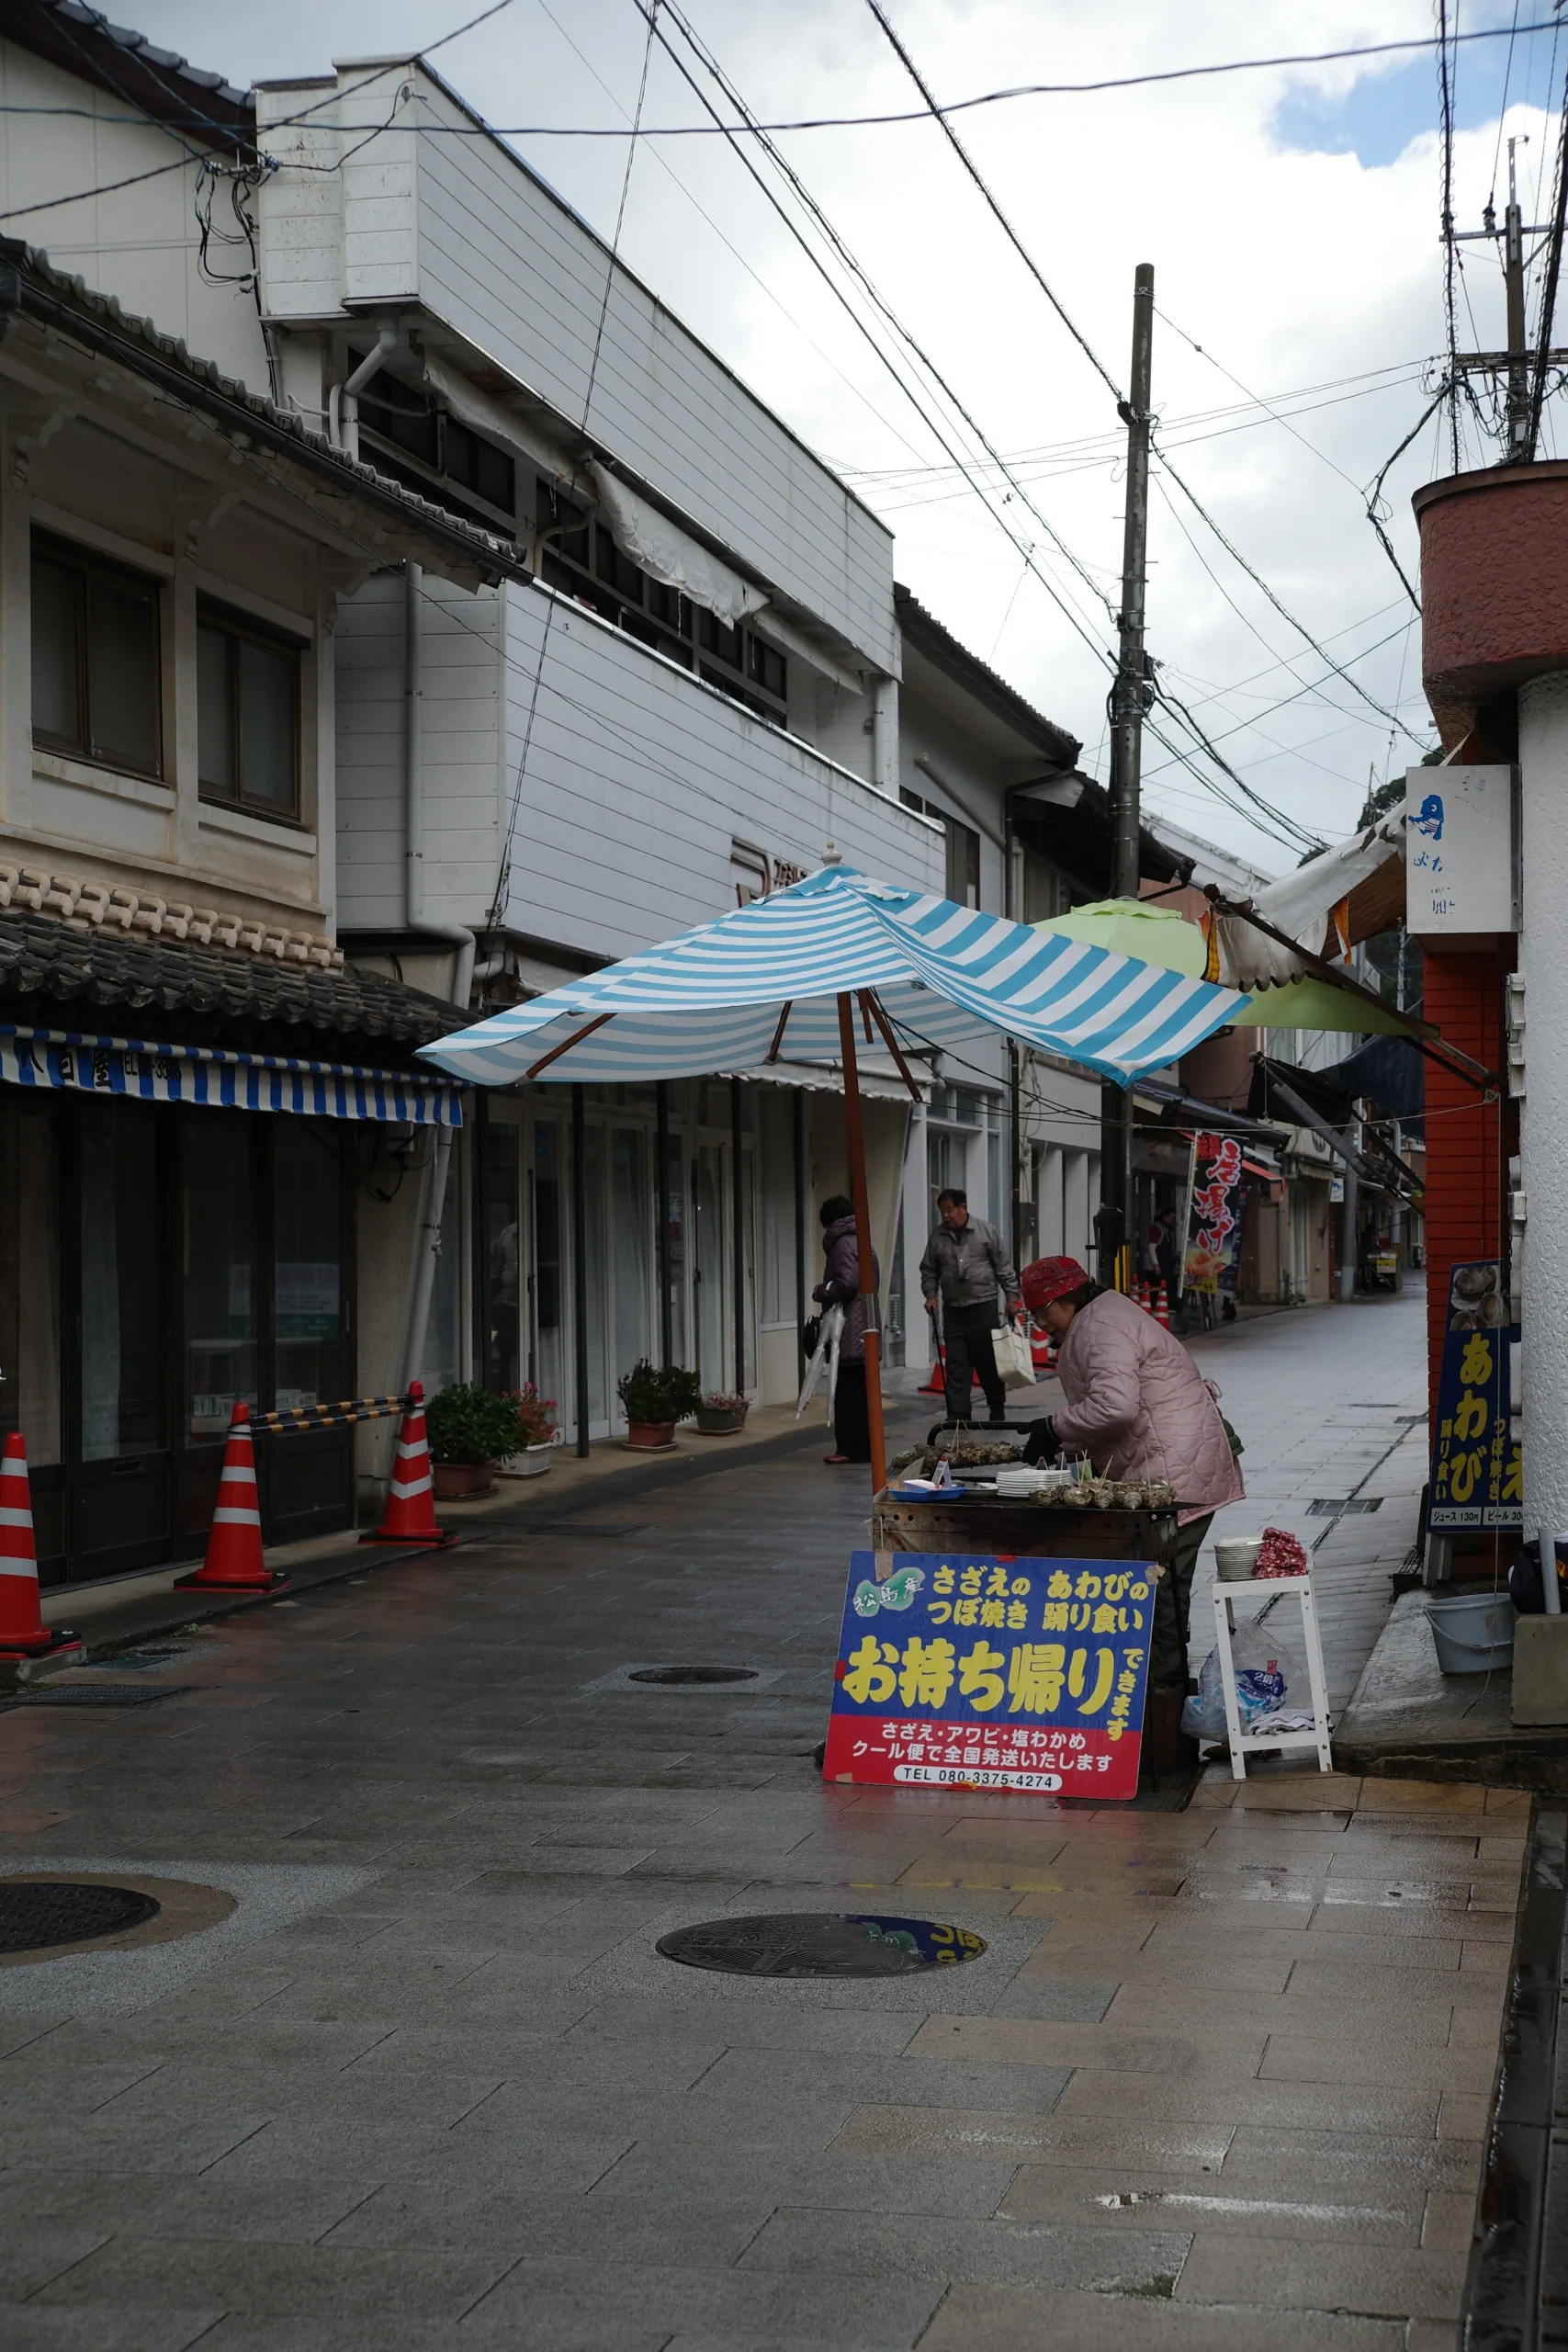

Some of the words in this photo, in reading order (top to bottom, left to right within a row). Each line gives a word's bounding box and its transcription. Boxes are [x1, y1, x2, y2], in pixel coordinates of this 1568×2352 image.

[1450, 1333, 1493, 1502] あわび
[1435, 1419, 1452, 1501] 踊り食い
[1489, 1418, 1506, 1501] つぼ焼き
[1433, 1511, 1457, 1522] ジュース
[1461, 1511, 1479, 1522] 130円
[1487, 1510, 1509, 1521] ビール
[1511, 1511, 1523, 1521] 30
[853, 1577, 925, 1613] 松島産
[933, 1565, 1031, 1597] さざえの
[1047, 1569, 1149, 1600] あわびの
[927, 1597, 1028, 1628] つぼ焼き
[1043, 1602, 1144, 1634] 踊り食い
[841, 1635, 1115, 1715] お持ち帰り
[1106, 1648, 1145, 1742] できます
[882, 1722, 1086, 1749] さざえ・アワビ・塩わかめ
[852, 1739, 1113, 1772] クール便で全国発送いたします
[903, 1768, 931, 1781] TEL
[939, 1770, 1053, 1789] 080-3375-4274
